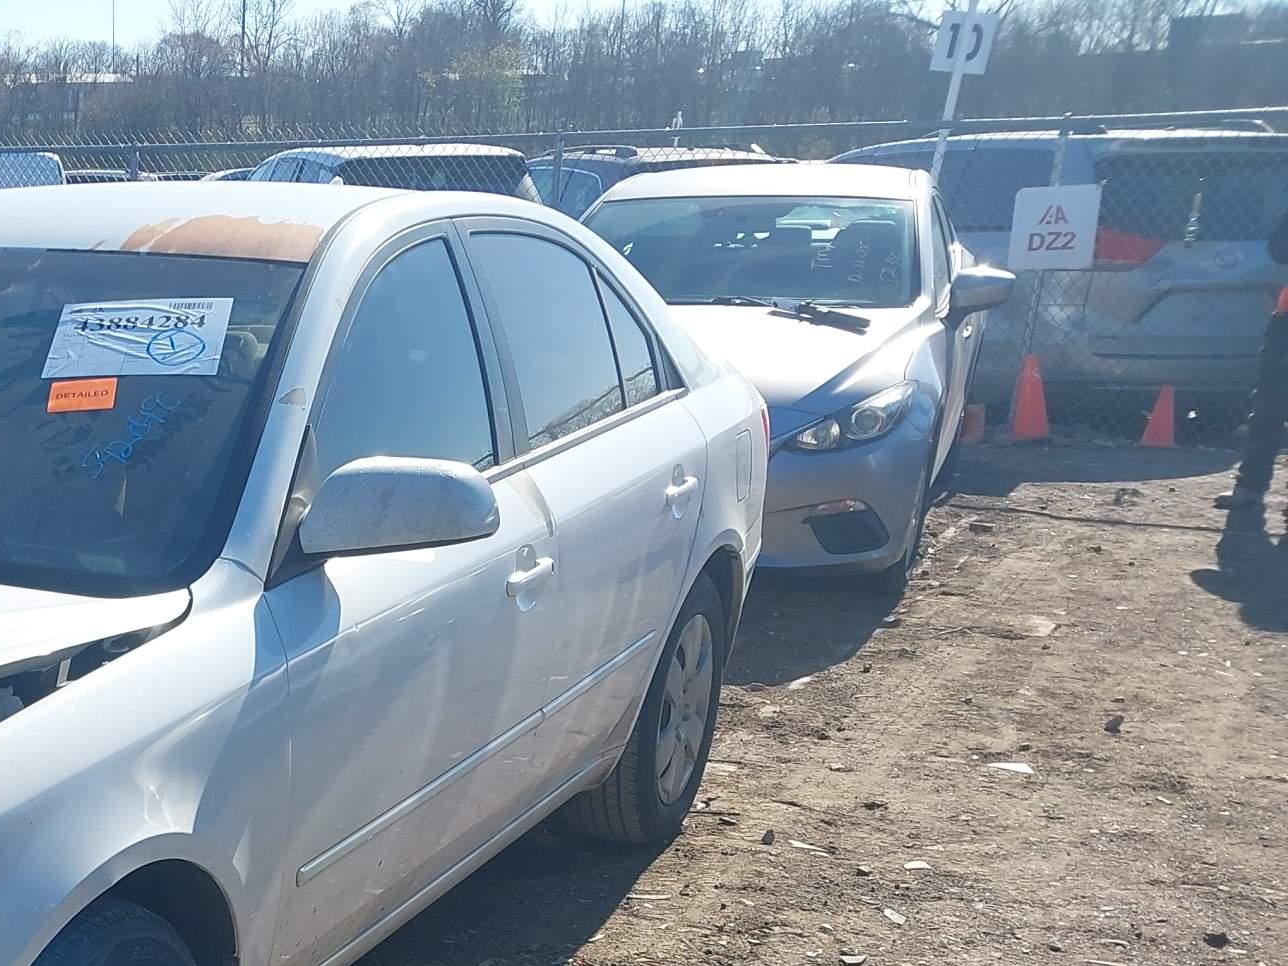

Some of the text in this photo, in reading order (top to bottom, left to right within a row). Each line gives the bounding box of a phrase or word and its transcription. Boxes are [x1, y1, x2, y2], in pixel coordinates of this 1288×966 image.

[1027, 231, 1077, 252] DZ2
[73, 313, 207, 332] 43884284
[55, 389, 110, 401] DETAILED
